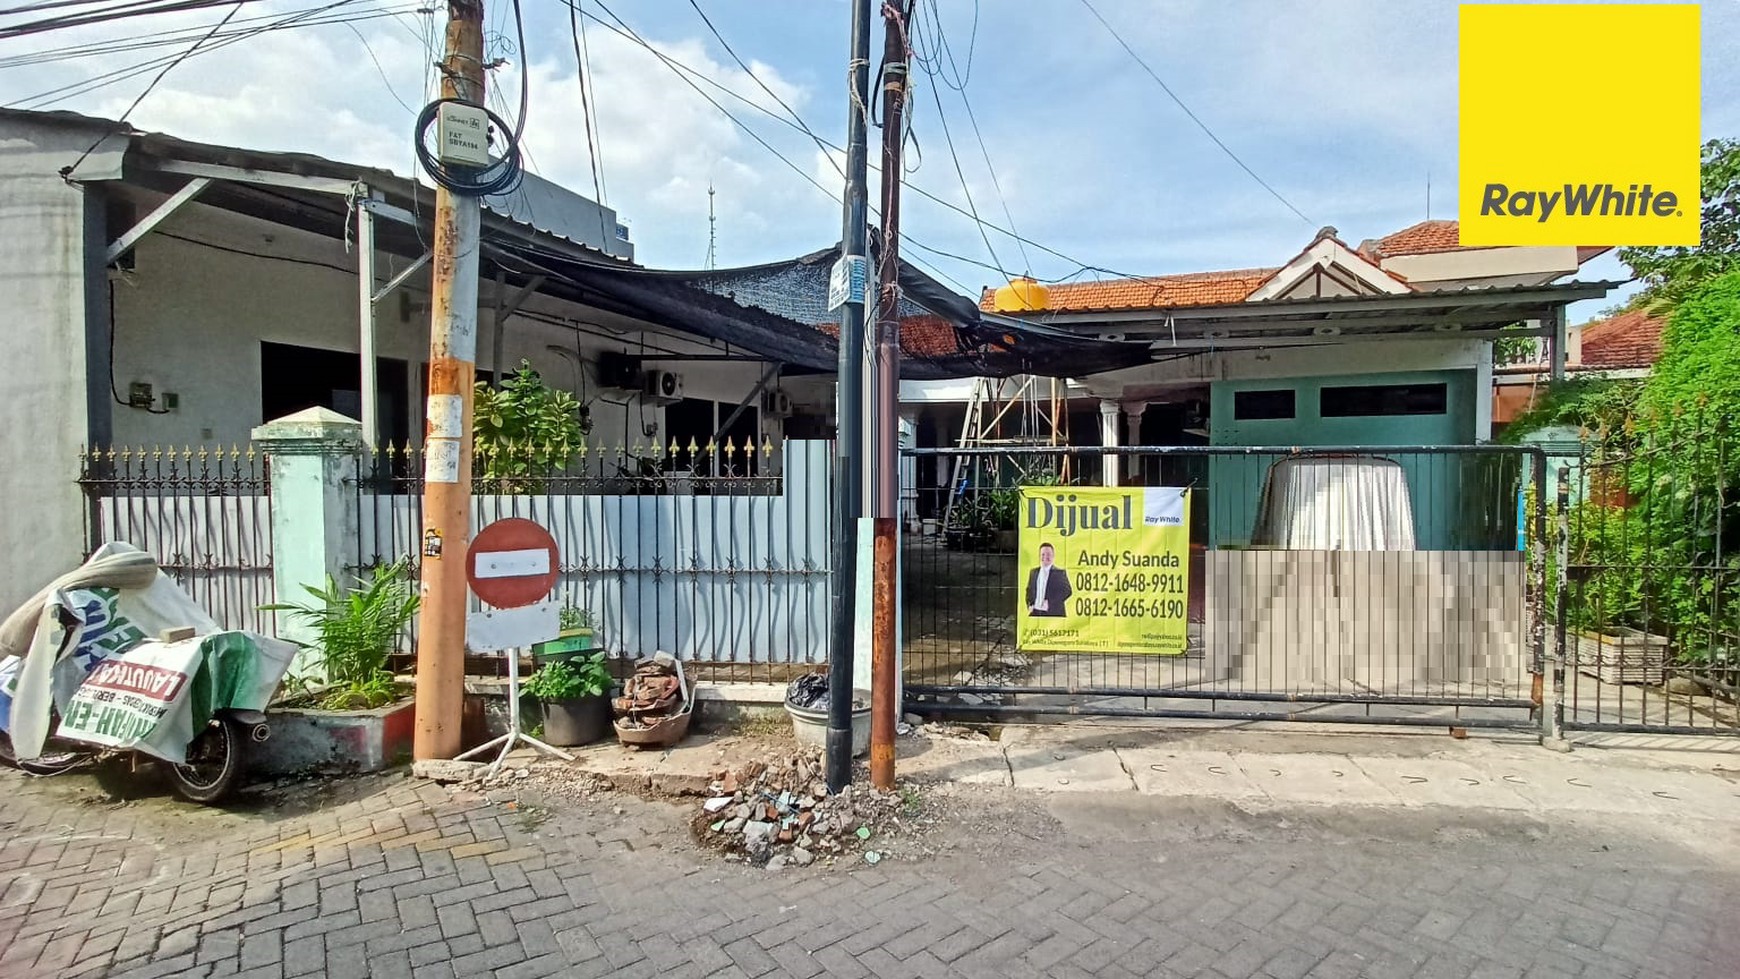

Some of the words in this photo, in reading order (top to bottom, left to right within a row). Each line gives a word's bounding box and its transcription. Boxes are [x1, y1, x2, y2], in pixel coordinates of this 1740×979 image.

[1025, 494, 1133, 537] Dijual
[1078, 550, 1119, 570] Andy
[1122, 551, 1179, 567] Suanda
[1076, 572, 1184, 594] 0812-1648-9911
[1075, 597, 1184, 619] 0812-1665-6190
